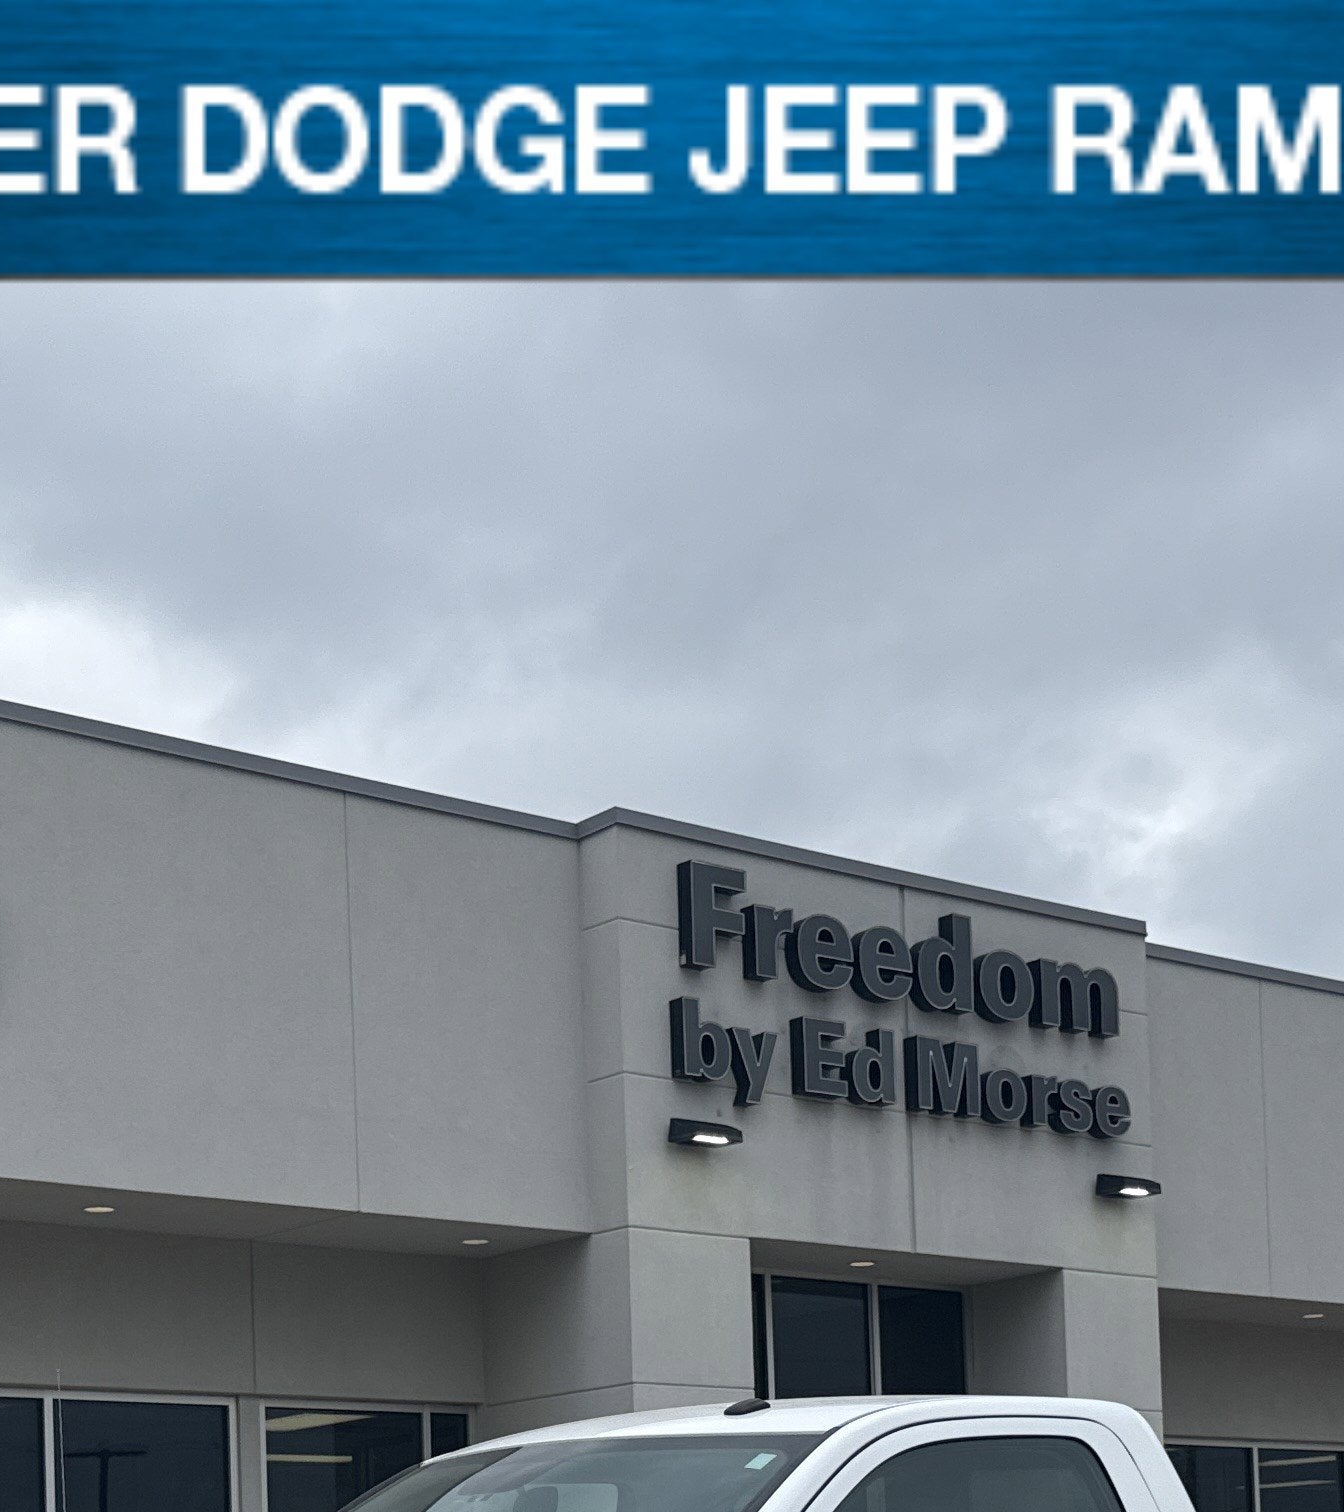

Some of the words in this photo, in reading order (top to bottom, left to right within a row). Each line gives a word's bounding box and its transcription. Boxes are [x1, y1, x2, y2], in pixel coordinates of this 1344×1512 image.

[676, 859, 1120, 1039] Freedom
[669, 996, 778, 1107] by
[790, 1016, 896, 1105] Ed
[903, 1034, 1132, 1139] Morse
